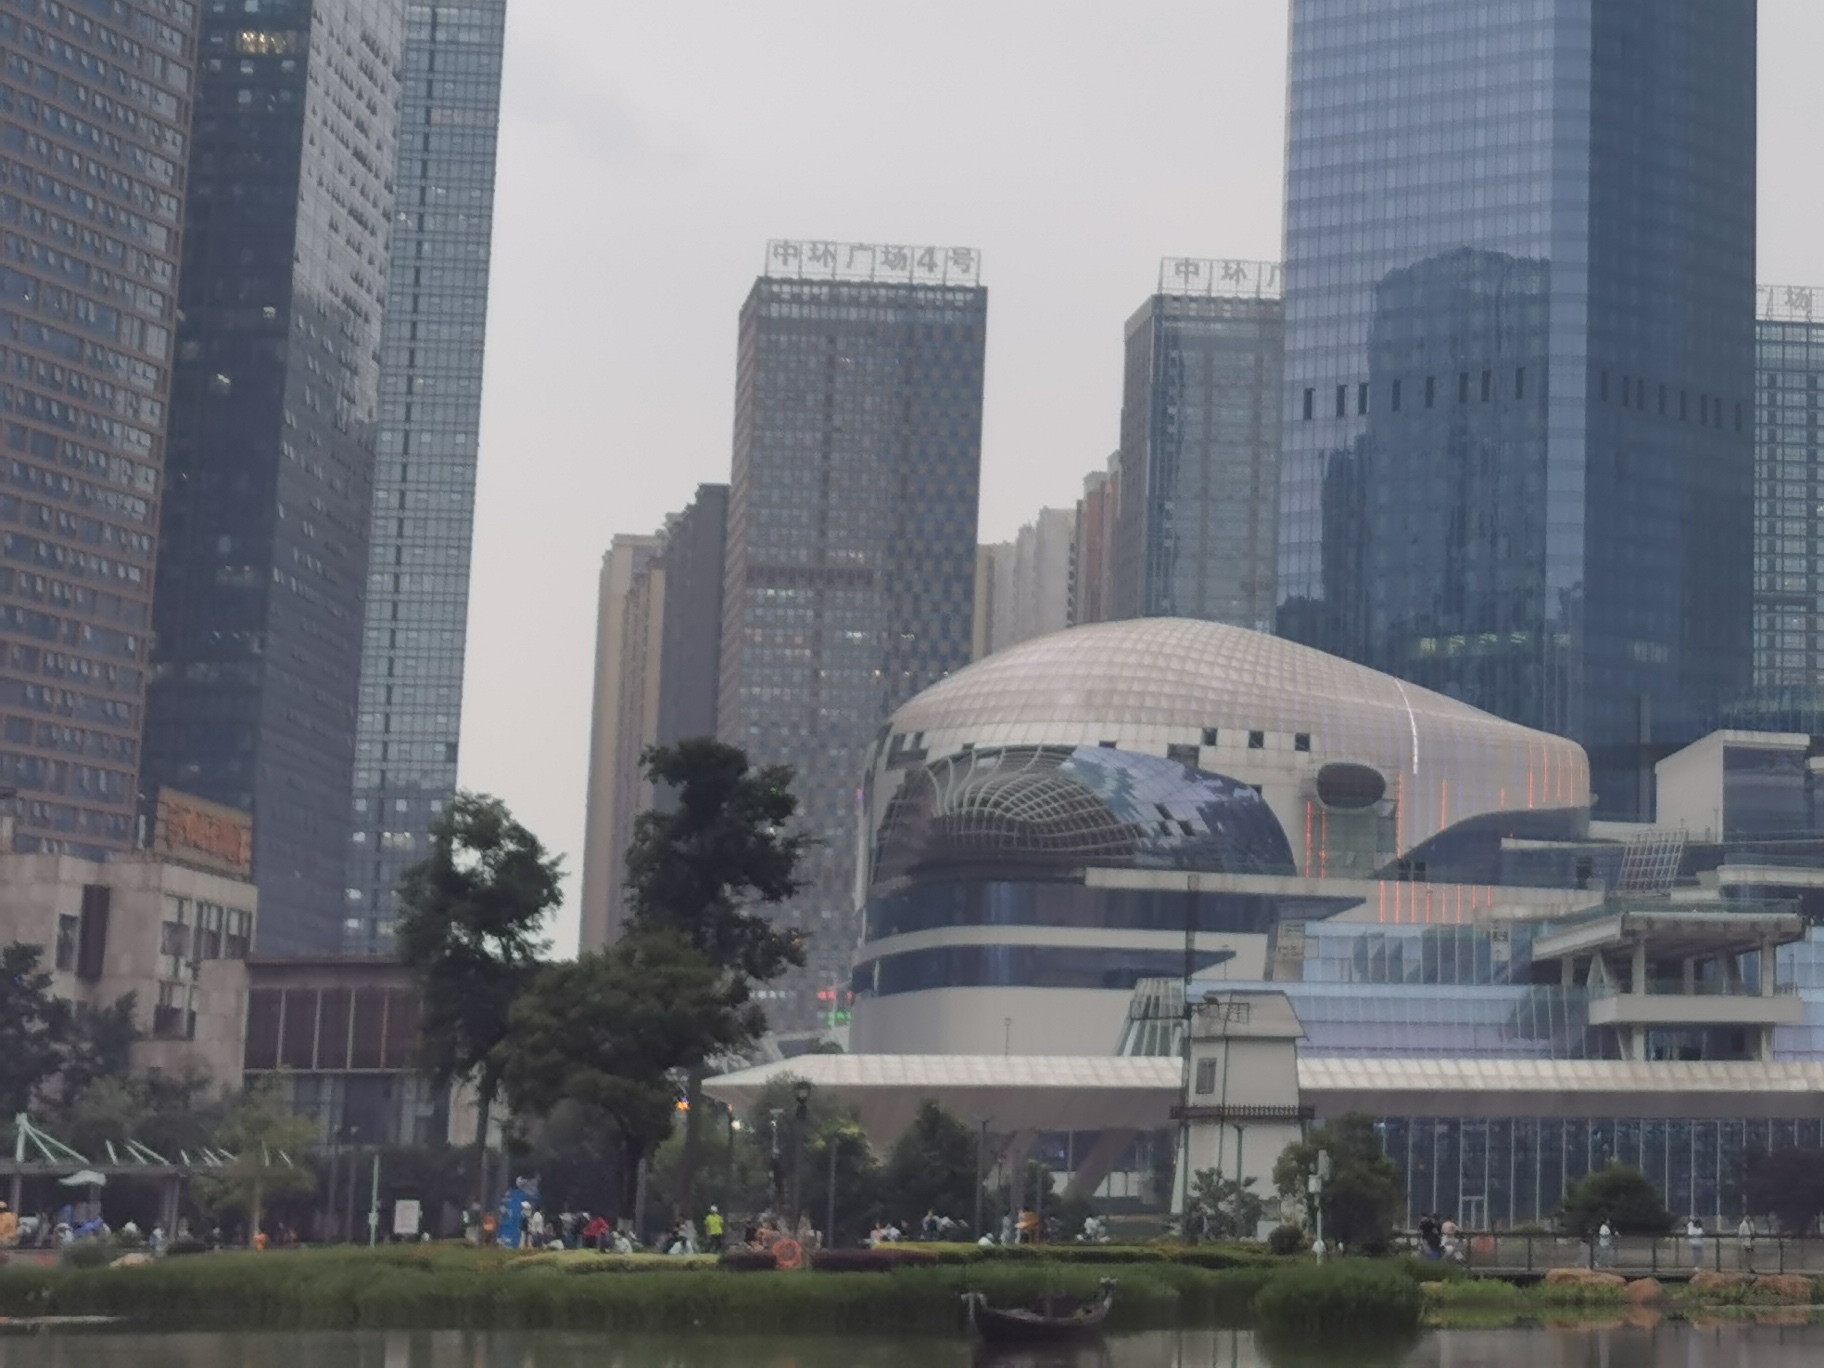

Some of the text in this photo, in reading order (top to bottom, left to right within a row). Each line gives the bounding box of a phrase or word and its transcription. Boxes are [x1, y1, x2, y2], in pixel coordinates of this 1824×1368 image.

[773, 240, 974, 274] 中环广场4号
